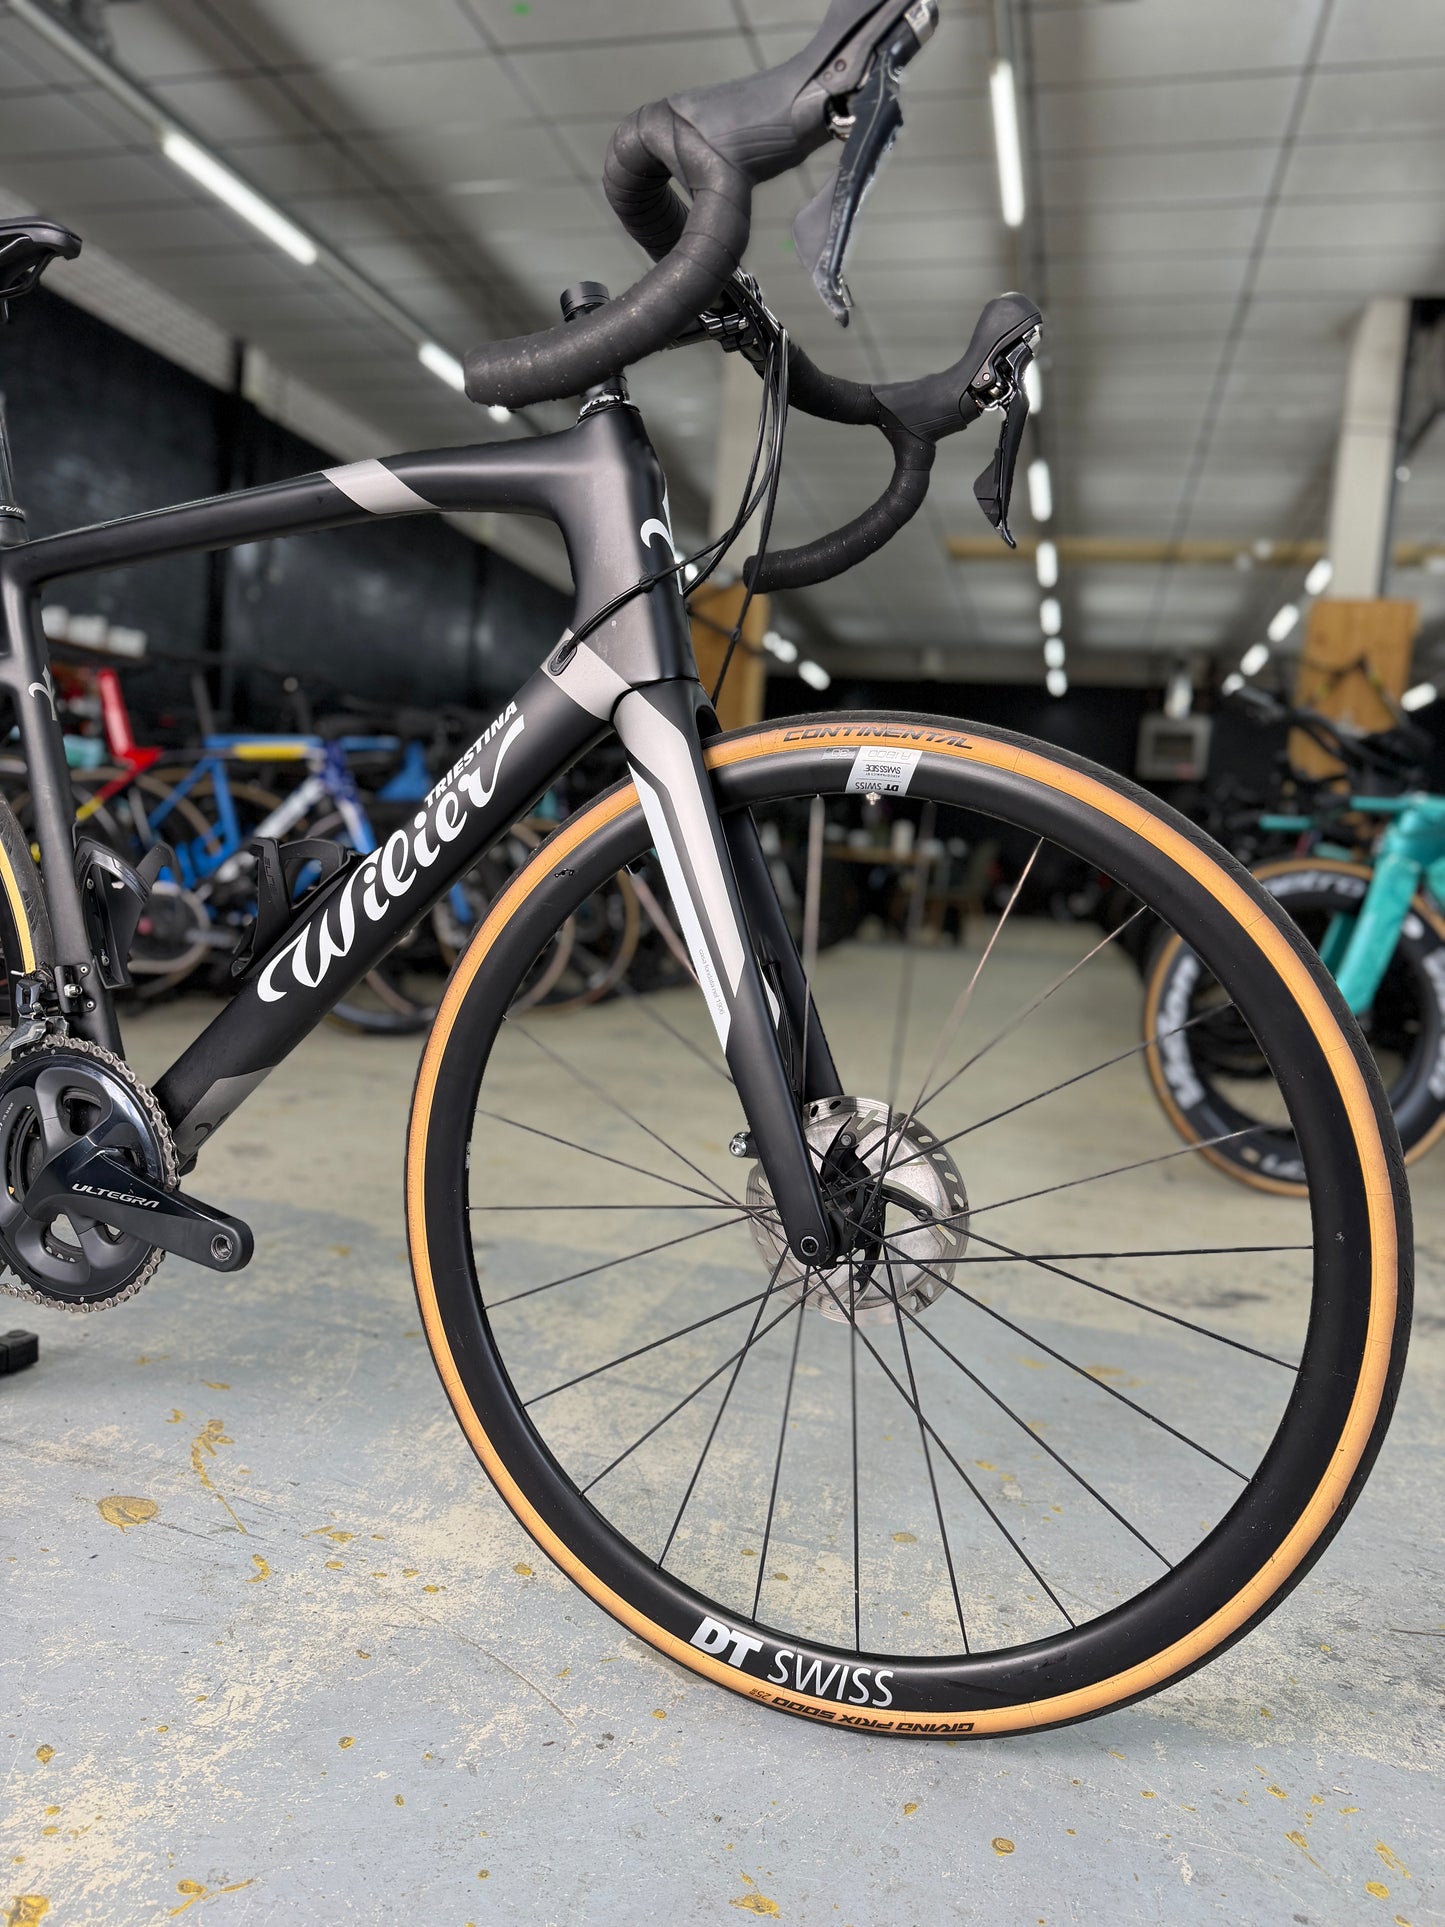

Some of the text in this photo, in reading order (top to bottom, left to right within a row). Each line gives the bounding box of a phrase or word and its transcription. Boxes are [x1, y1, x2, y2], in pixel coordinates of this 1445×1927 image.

[783, 726, 973, 749] CONTINENTAL
[424, 701, 518, 808] TRIESTINA
[855, 782, 882, 790] SWISS
[257, 714, 526, 1002] Wilier
[72, 1183, 160, 1209] ULTEGRA
[689, 1616, 894, 1707] DT SWISS
[771, 1696, 837, 1720] 5000
[838, 1714, 896, 1730] PRIX
[895, 1722, 975, 1733] GRAND
